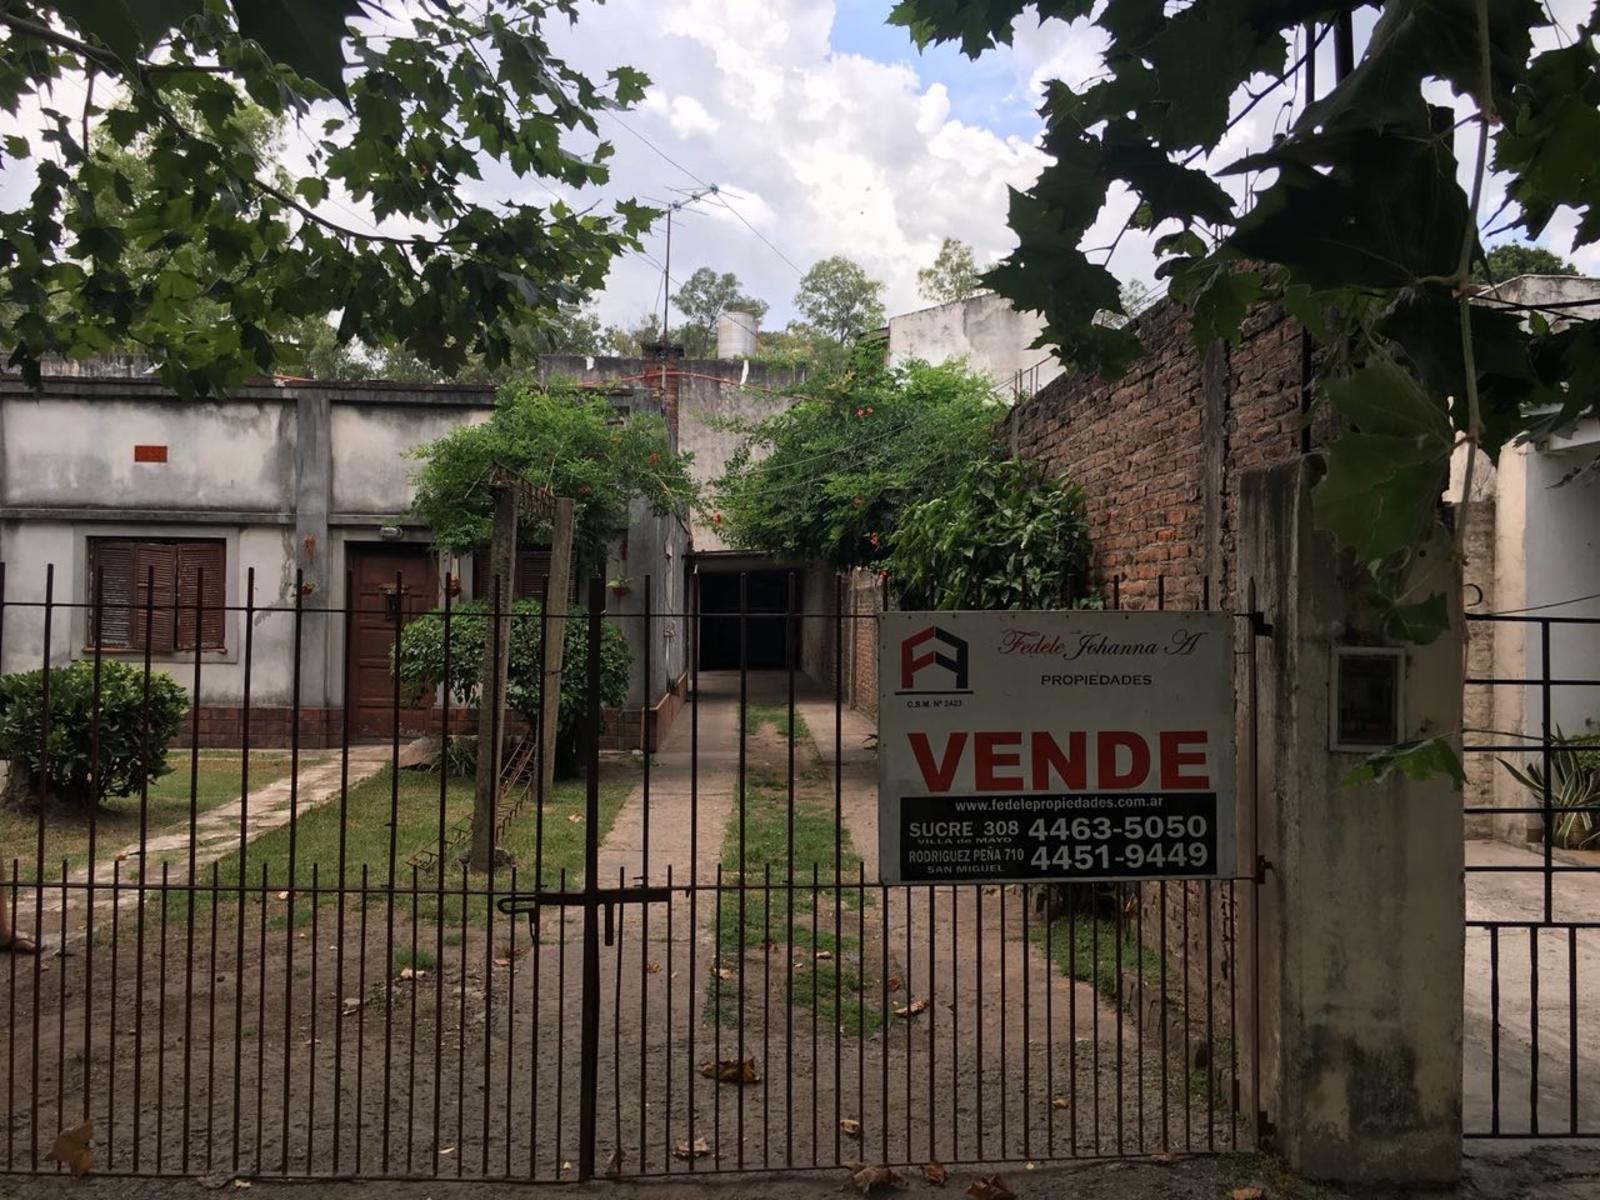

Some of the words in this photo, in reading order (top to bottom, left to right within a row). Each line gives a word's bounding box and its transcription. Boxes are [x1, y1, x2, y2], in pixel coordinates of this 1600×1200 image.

[997, 629, 1065, 656] Fedele
[1063, 630, 1157, 660] Johanna
[1164, 629, 1208, 656] A
[1041, 674, 1152, 686] PROPIEDADES
[907, 731, 1210, 791] VENDE
[955, 797, 1163, 811] www.fedelepropiedades.com.ar
[909, 821, 973, 837] SUCRE
[984, 820, 1019, 836] 308
[1028, 815, 1207, 841] 4463-5050
[909, 849, 970, 863] RODRIGUEZ
[973, 846, 1001, 861] PEÑA
[1004, 848, 1024, 861] 710
[1030, 842, 1208, 870] 4451-9449
[927, 865, 952, 873] SAN
[956, 864, 1005, 873] MIGUEL
